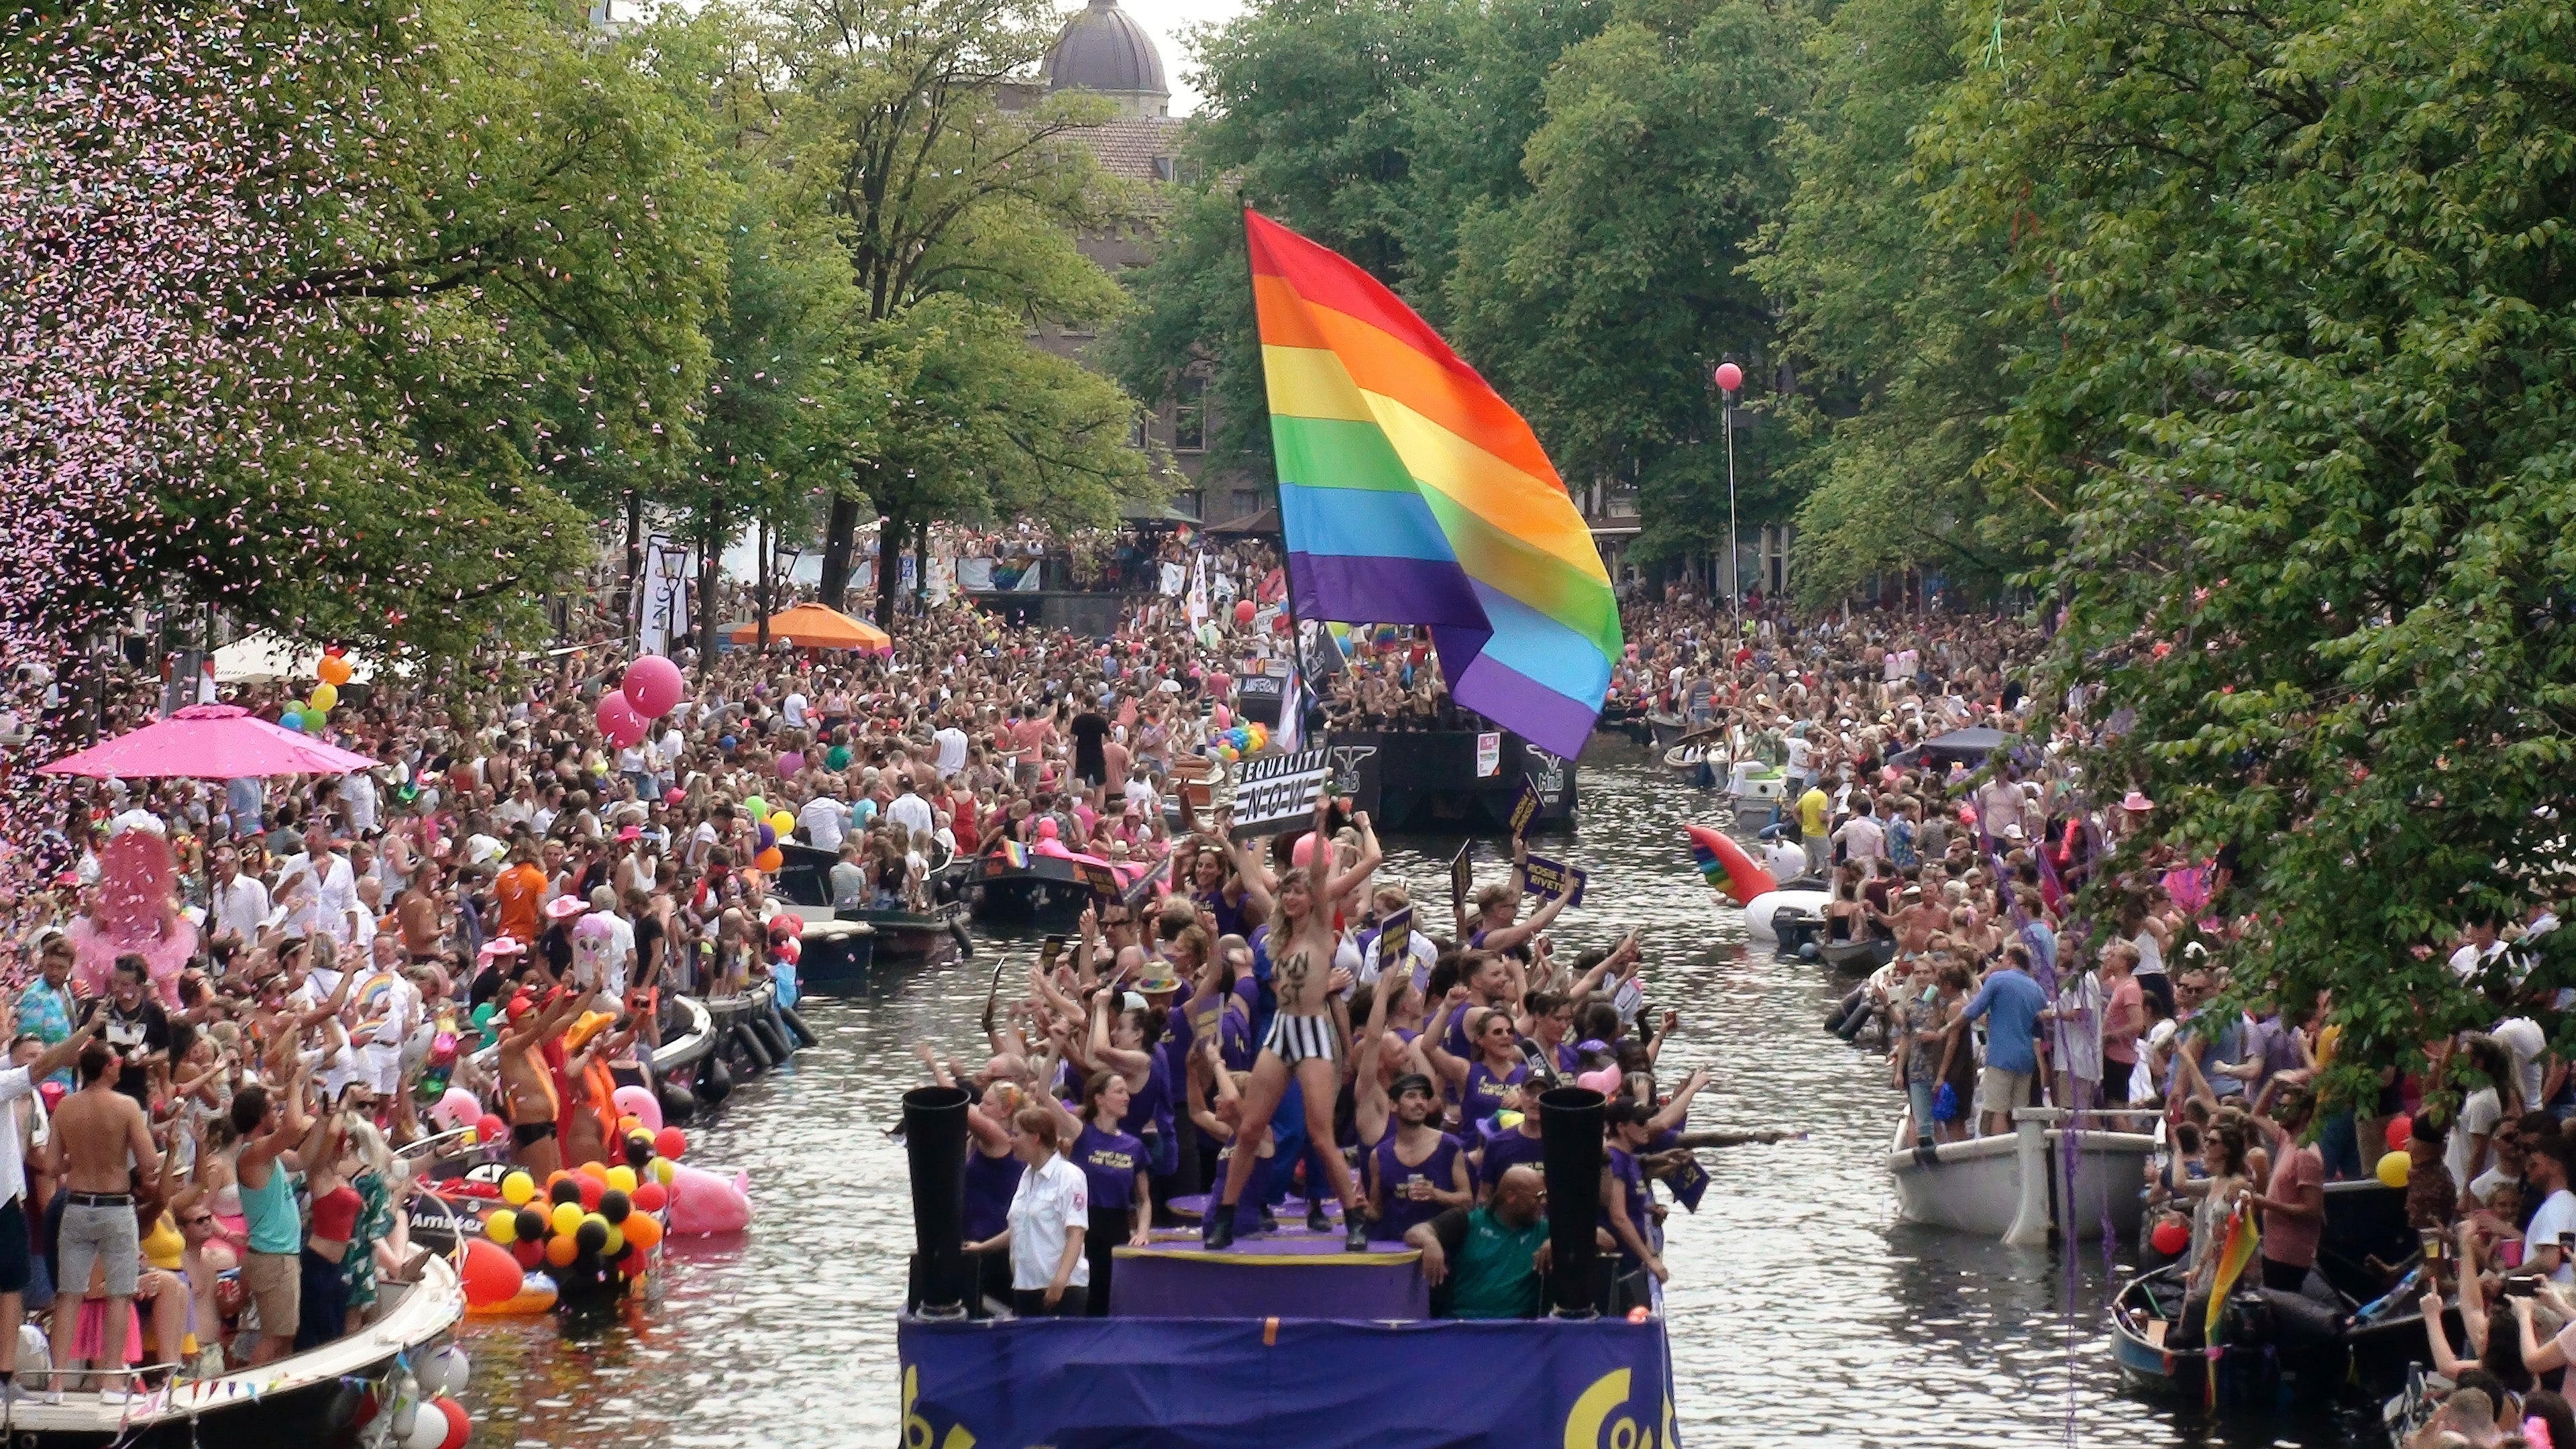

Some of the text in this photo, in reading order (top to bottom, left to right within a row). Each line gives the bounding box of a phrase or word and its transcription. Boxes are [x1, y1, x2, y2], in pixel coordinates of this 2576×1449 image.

[1245, 748, 1325, 782] EQUALITY
[1245, 778, 1309, 821] NOW
[1527, 863, 1558, 881] ROSIE
[1530, 874, 1566, 894] RIVETE
